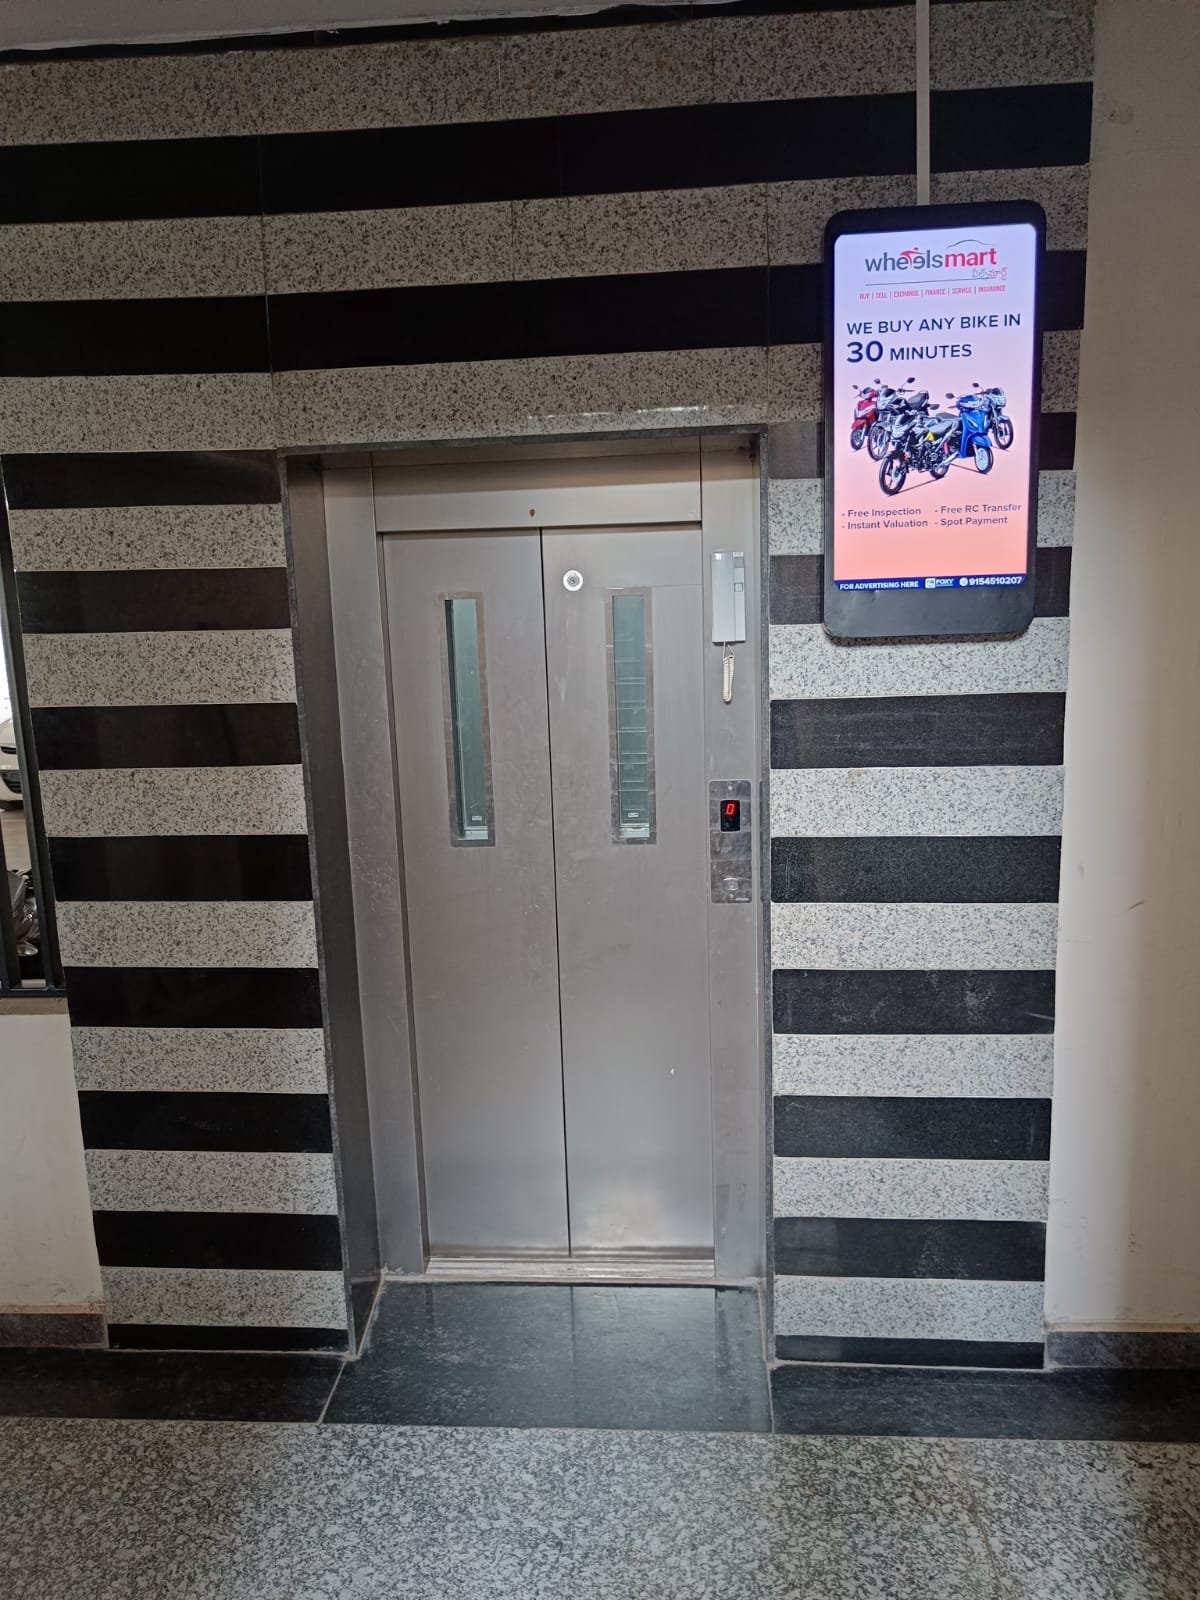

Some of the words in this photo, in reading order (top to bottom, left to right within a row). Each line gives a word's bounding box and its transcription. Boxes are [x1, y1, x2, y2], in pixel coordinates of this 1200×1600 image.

[893, 290, 919, 298] EXCHANGE
[925, 288, 946, 296] FINANCE
[951, 287, 972, 295] SERVICE
[978, 285, 1006, 293] INSURANCE
[847, 322, 873, 335] WE
[878, 320, 914, 333] BUY
[919, 317, 956, 331] ANY
[960, 315, 999, 329] BIKE
[1004, 313, 1021, 326] IN
[847, 340, 883, 363] 30
[890, 344, 972, 361] MINUTES
[847, 509, 869, 517] Free
[872, 507, 921, 518] Inspection
[940, 505, 962, 514] Free
[965, 504, 979, 513] RC
[982, 503, 1022, 512] Transfer
[847, 521, 880, 529] Instant
[883, 519, 928, 528] Valuation
[940, 518, 963, 527] Spot
[965, 516, 1008, 526] Payment
[855, 581, 900, 589] ADVERTISING
[969, 577, 1022, 586] 9154510207
